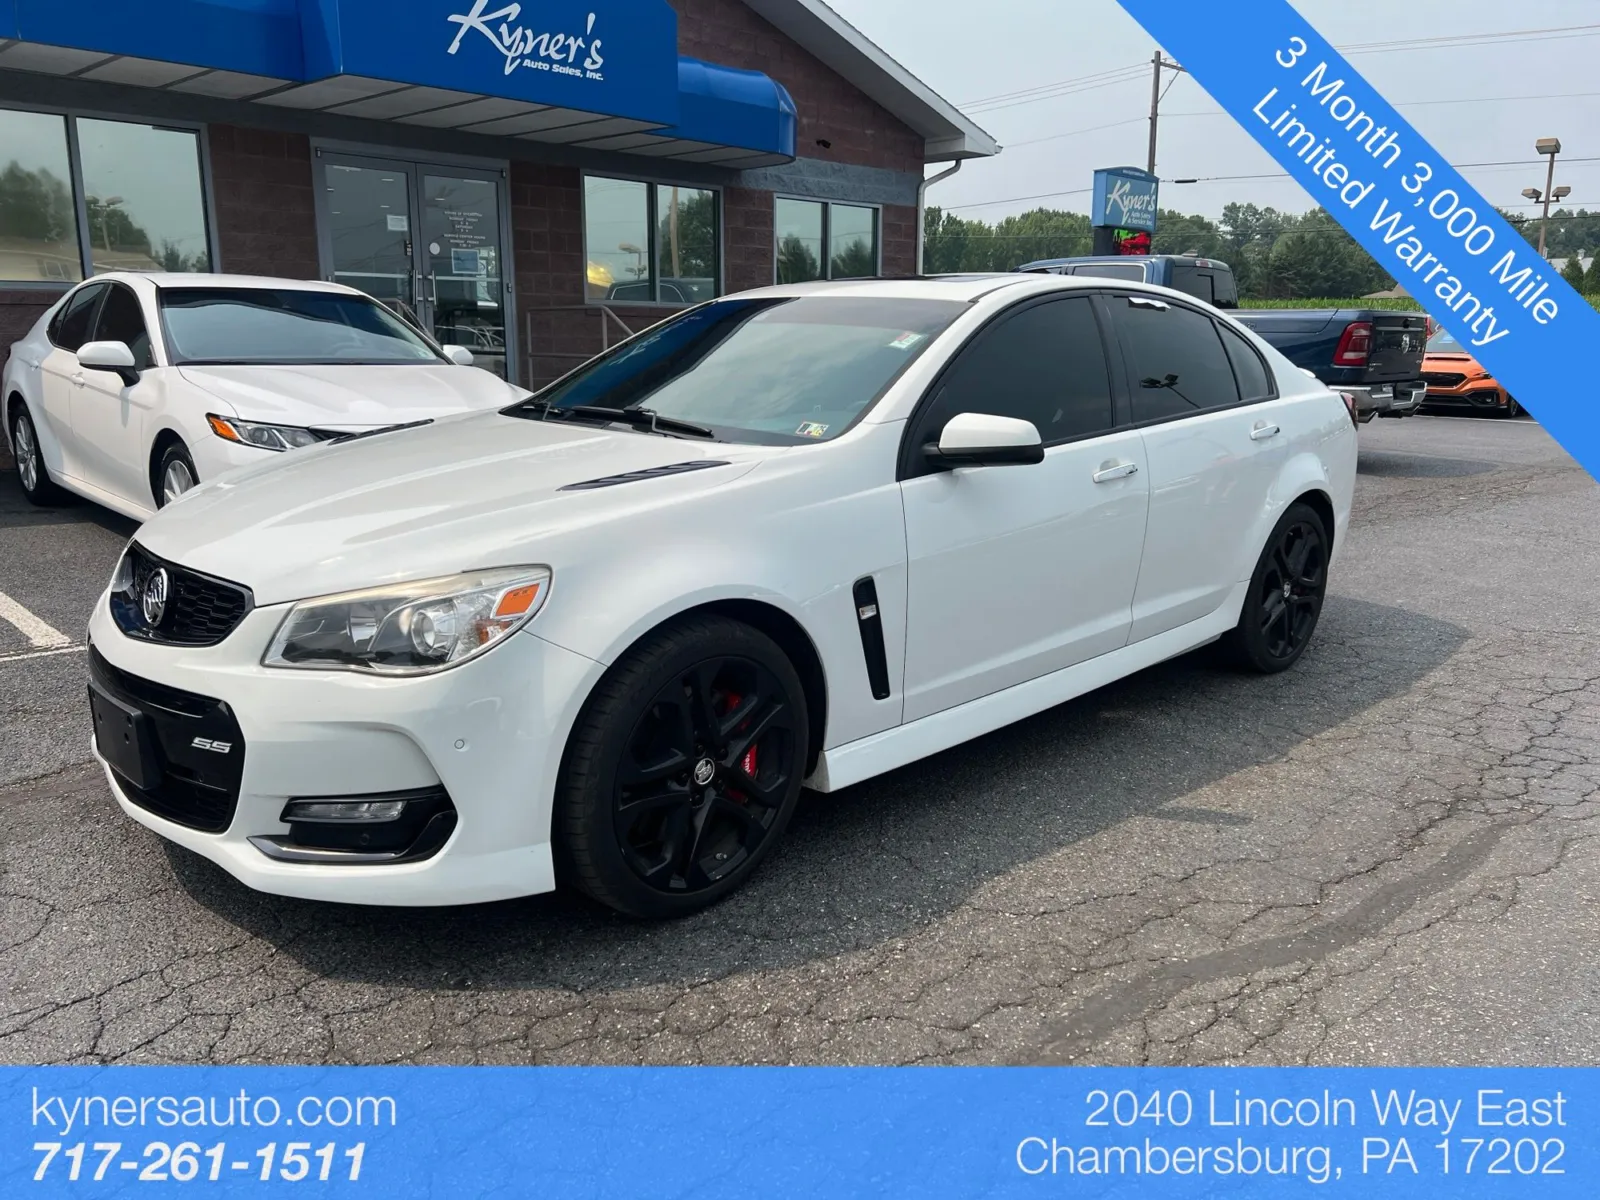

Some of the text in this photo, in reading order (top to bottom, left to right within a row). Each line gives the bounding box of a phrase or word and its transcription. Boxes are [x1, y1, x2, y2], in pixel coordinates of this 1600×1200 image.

[447, 0, 604, 76] Kyner's
[523, 58, 604, 81] Auto Sales, Inc.
[1106, 179, 1156, 225] Kyner's
[191, 736, 232, 754] SS
